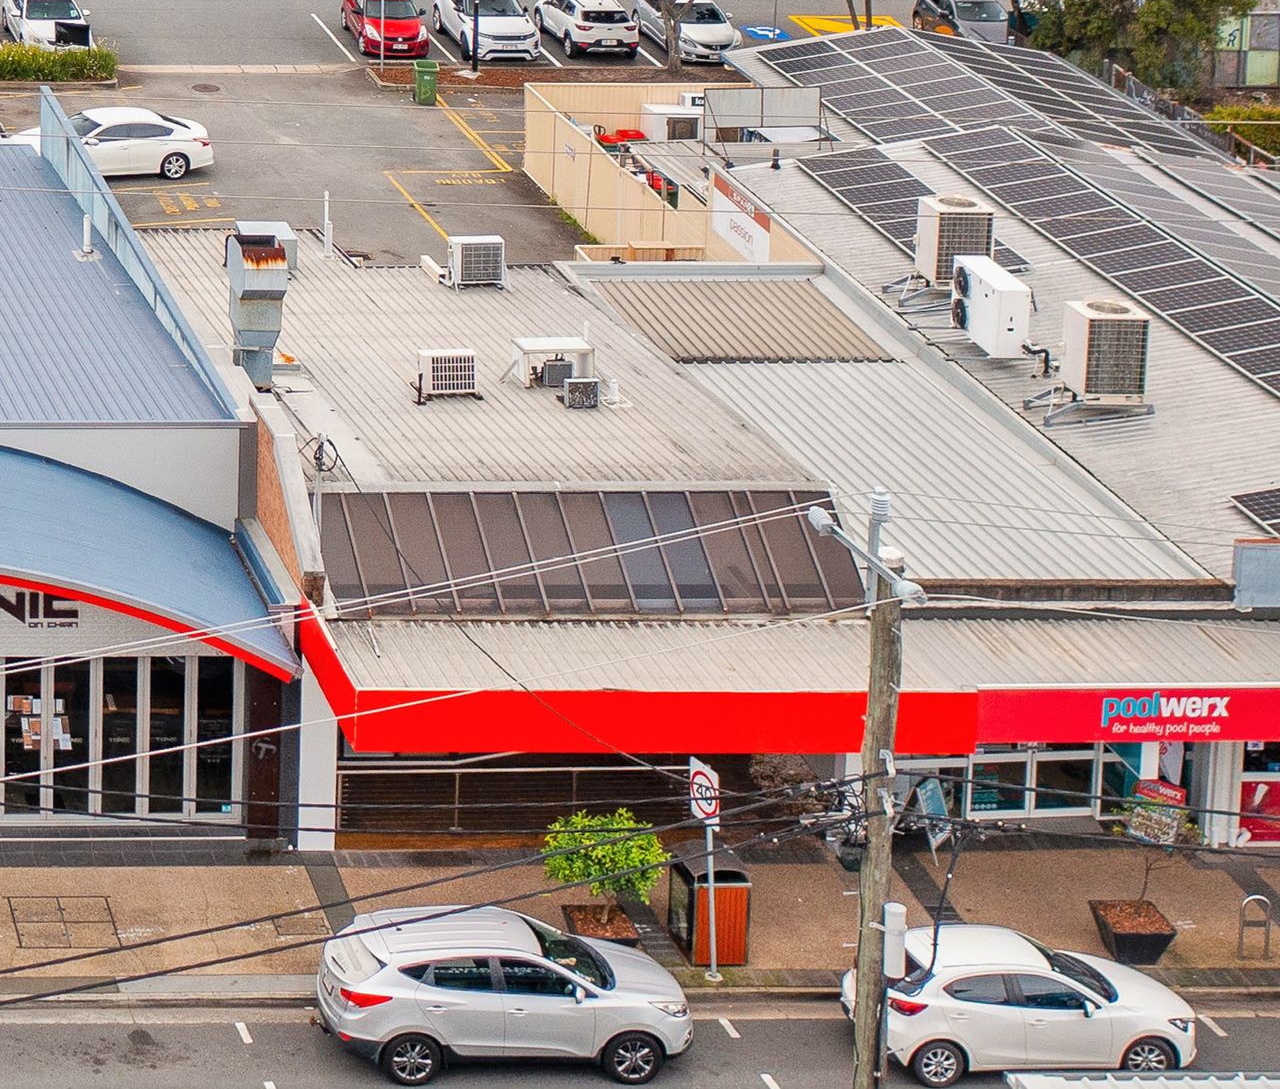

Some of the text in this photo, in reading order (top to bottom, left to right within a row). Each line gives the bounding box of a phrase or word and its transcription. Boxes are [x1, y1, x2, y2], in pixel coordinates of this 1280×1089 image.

[1101, 691, 1231, 728] poolwerx
[1111, 722, 1222, 736] for healthy pool people
[696, 783, 713, 807] 40
